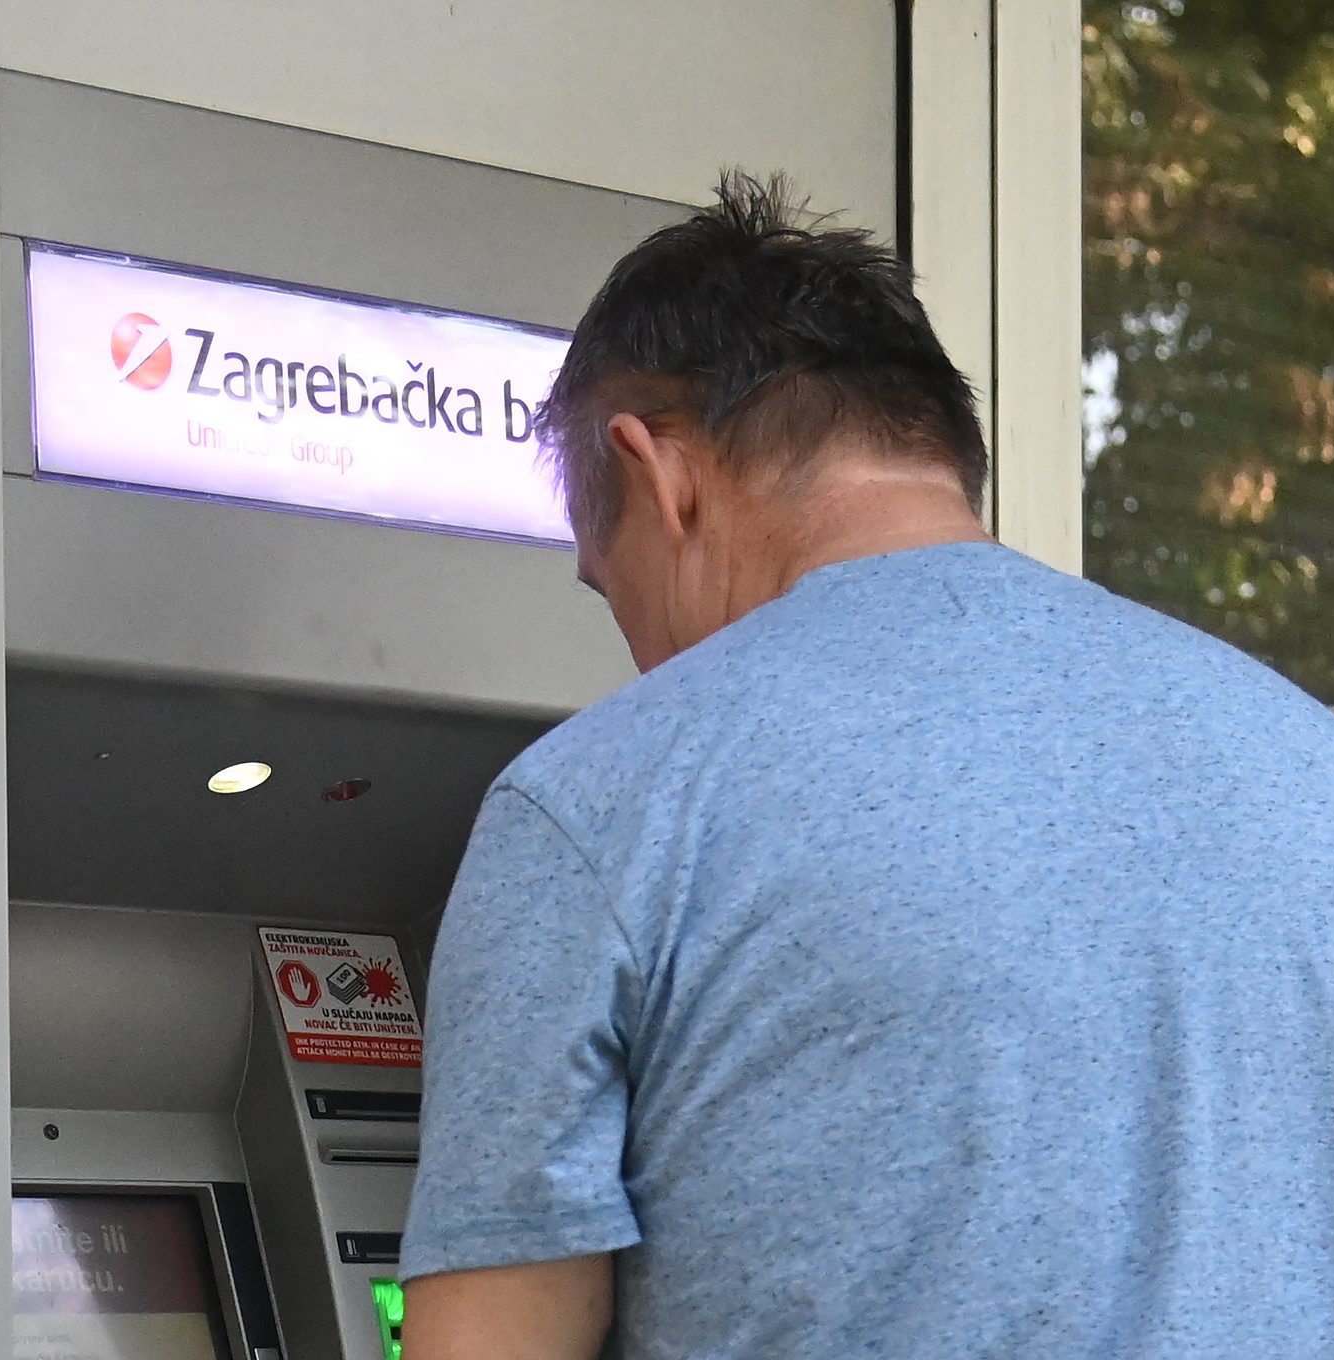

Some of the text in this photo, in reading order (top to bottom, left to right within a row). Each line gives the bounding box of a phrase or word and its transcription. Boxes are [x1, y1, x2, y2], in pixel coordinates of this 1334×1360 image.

[185, 328, 483, 436] Zagrebačka
[291, 433, 354, 475] Group
[268, 942, 306, 954] ZAŠTITA
[336, 969, 351, 984] 100
[322, 1007, 414, 1022] U SLUČAJU NAPADA
[305, 1019, 338, 1030] NOVAC
[354, 1022, 373, 1032] BITI
[374, 1021, 418, 1035] UNIŠTEN.
[297, 1046, 325, 1056] ATTACK
[309, 1038, 352, 1048] PROTECTED
[380, 1041, 399, 1051] CASE
